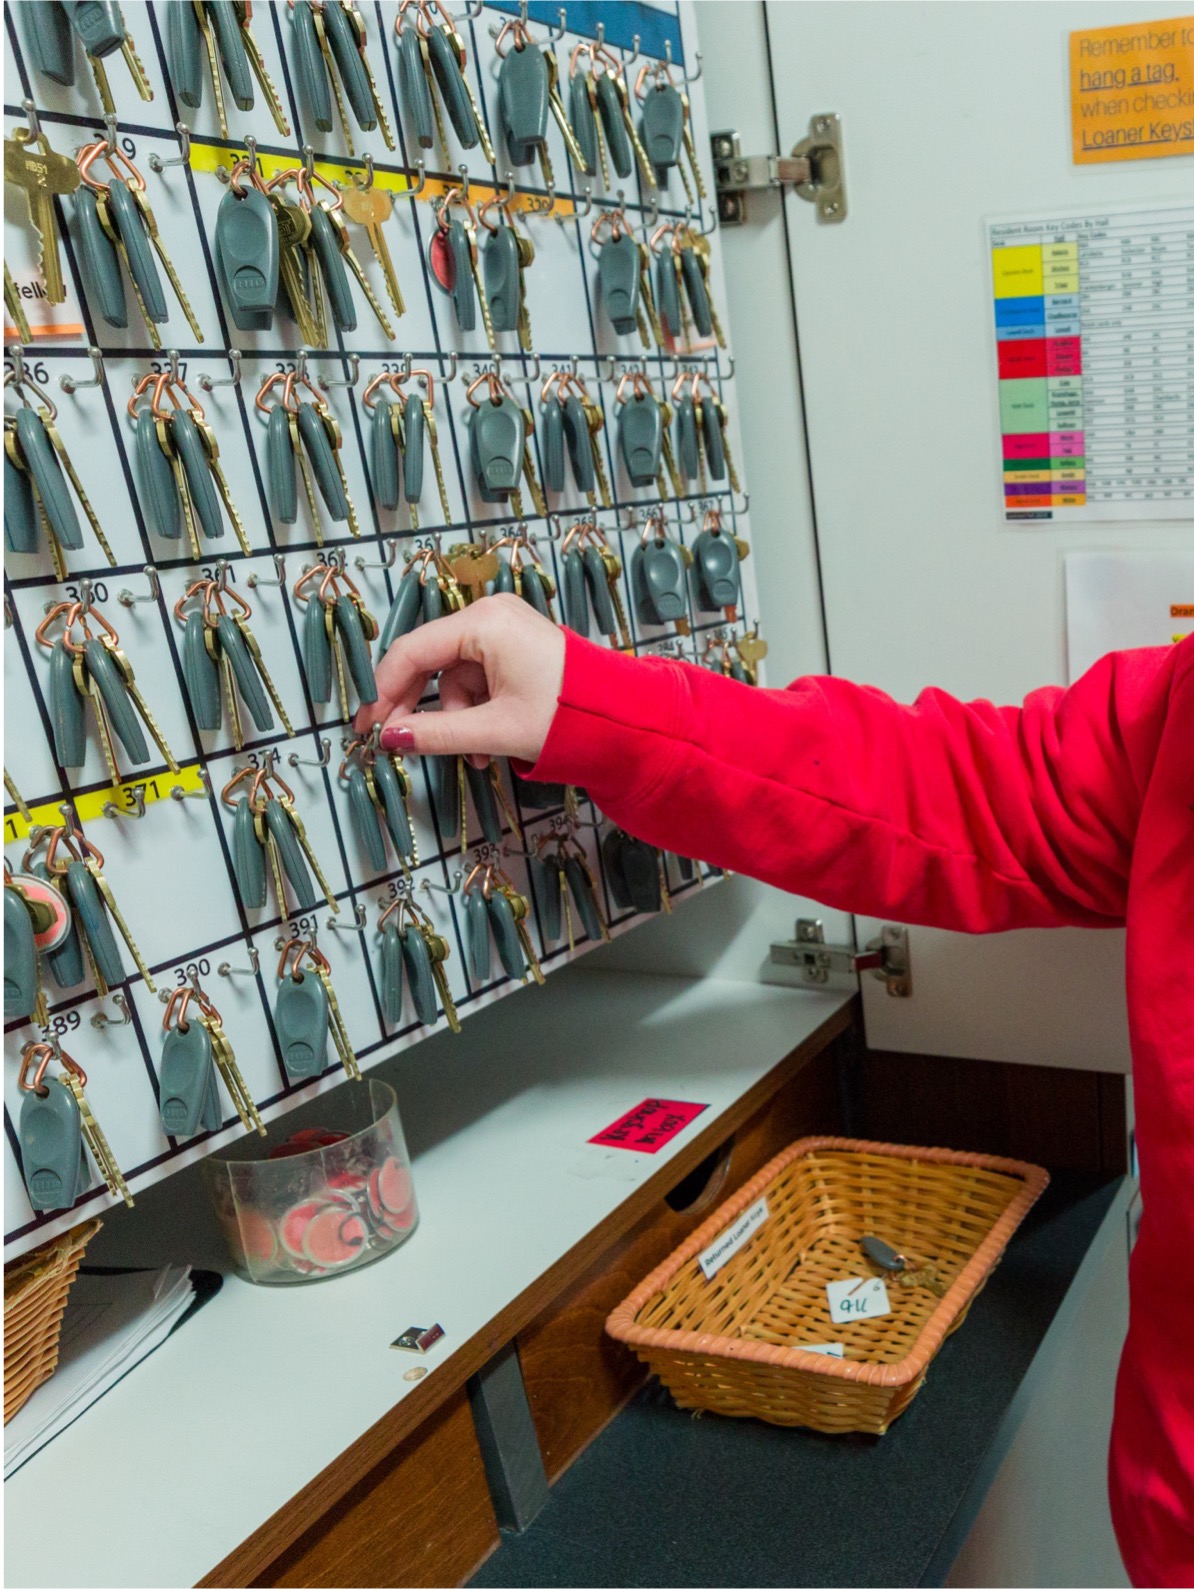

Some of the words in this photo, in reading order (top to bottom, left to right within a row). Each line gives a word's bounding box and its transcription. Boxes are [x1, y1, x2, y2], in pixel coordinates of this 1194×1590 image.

[1079, 29, 1175, 58] Remember
[1079, 68, 1126, 88] hang
[1130, 67, 1141, 82] a
[1080, 97, 1129, 118] when
[1082, 124, 1144, 147] Loaner
[276, 362, 309, 380] 33
[317, 551, 348, 568] 36
[289, 914, 318, 940] 391
[704, 1237, 734, 1267] Returned
[733, 1219, 750, 1240] Loaner
